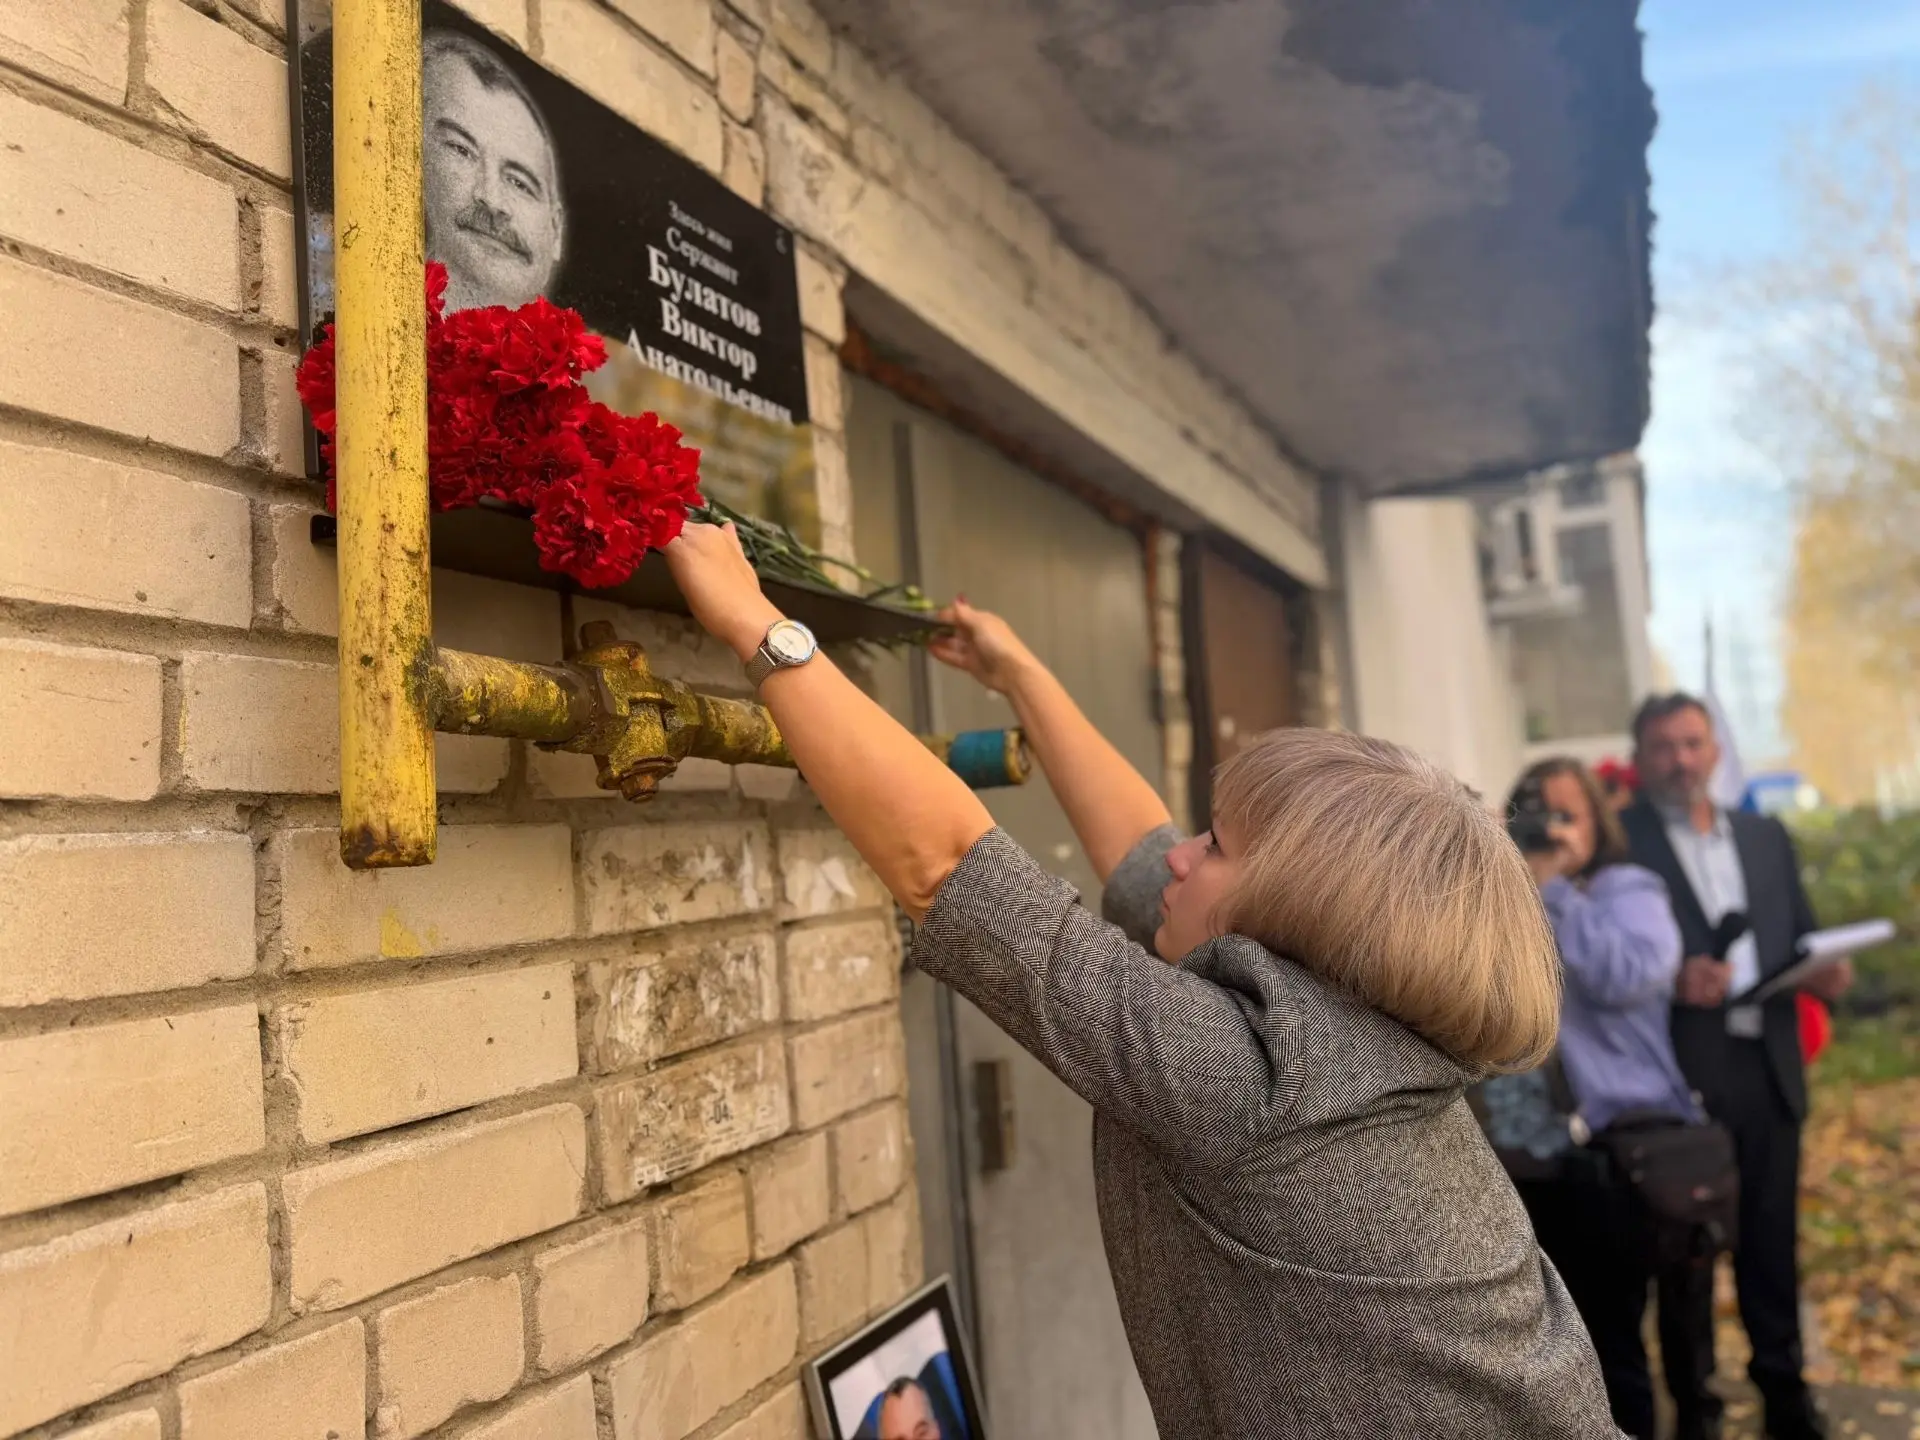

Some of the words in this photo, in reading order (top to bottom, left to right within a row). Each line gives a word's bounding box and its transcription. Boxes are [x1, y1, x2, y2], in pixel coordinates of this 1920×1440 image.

[646, 244, 761, 336] Булатов
[666, 226, 739, 286] Сержант
[660, 298, 757, 380] Виктор
